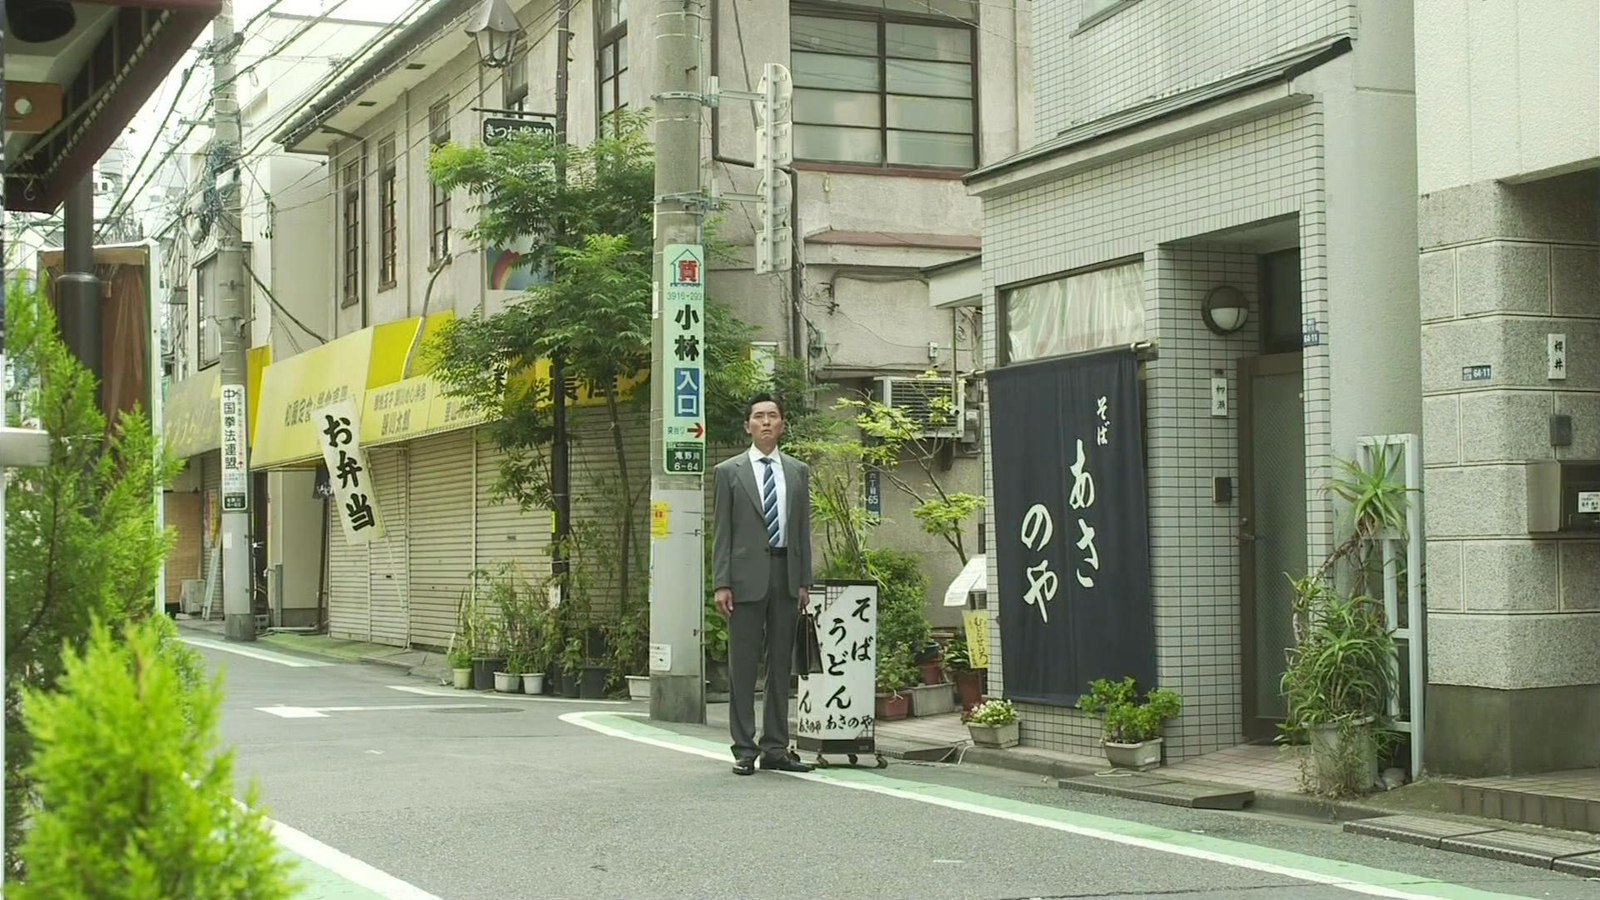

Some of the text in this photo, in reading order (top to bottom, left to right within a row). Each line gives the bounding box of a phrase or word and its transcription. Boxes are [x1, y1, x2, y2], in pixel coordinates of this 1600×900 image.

[678, 259, 698, 283] 質
[674, 304, 700, 361] 小林
[677, 370, 698, 415] 入口
[1473, 367, 1490, 378] 64-11
[223, 388, 238, 470] 中国拳法連盟
[1096, 395, 1111, 446] そば
[323, 414, 376, 532] お弁当
[674, 462, 698, 471] 6-64
[868, 495, 879, 505] 65
[1069, 438, 1099, 588] あさ
[1021, 503, 1058, 623] のや
[852, 597, 873, 661] そば
[825, 618, 852, 710] うどん
[826, 714, 873, 730] あさのや
